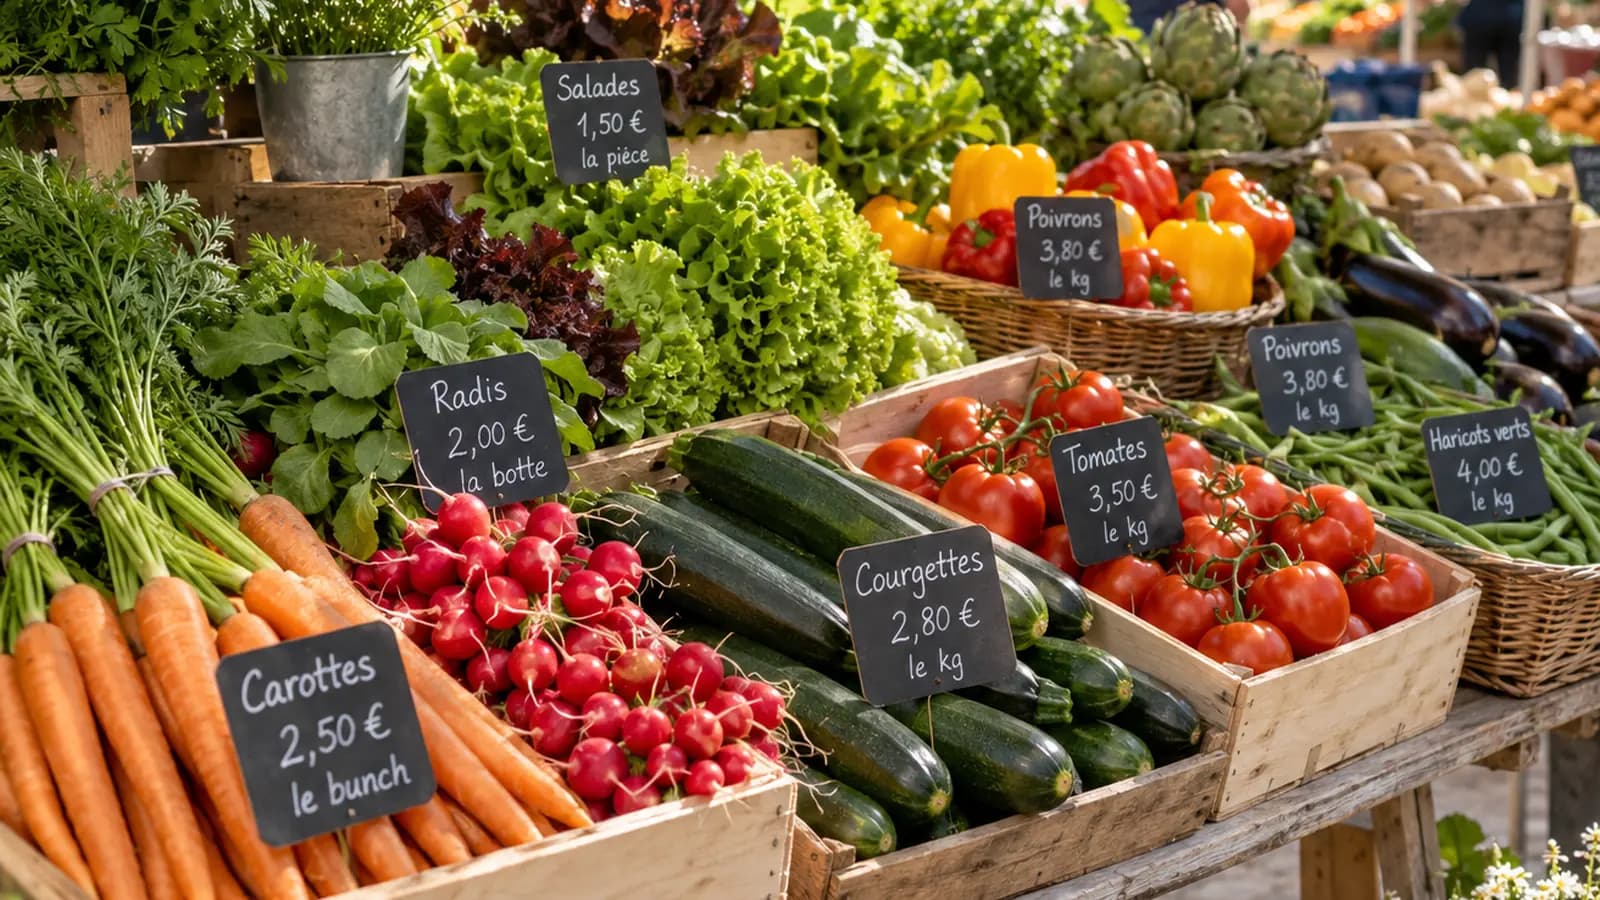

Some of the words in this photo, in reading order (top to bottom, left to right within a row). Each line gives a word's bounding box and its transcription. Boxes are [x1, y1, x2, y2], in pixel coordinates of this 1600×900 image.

[556, 71, 641, 102] Salades
[576, 111, 624, 142] 1,50
[629, 108, 647, 134] €
[581, 147, 599, 169] la
[1027, 203, 1103, 230] Poivrons
[1039, 239, 1083, 266] 3,80
[1088, 239, 1104, 262] €
[1049, 268, 1063, 289] le
[1071, 268, 1091, 296] kg
[1261, 335, 1343, 363] Poivrons
[430, 375, 508, 414] Radis
[1282, 369, 1328, 397] 3,80
[1332, 365, 1350, 389] €
[1295, 400, 1312, 422] le
[1318, 397, 1341, 425] kg
[448, 421, 506, 460] 2,00
[513, 413, 536, 442] €
[1428, 423, 1492, 452] Haricots
[1493, 416, 1532, 442] verts
[1061, 436, 1148, 475] Tomates
[1456, 456, 1502, 486] 4,00
[1506, 452, 1524, 477] €
[460, 468, 484, 494] la
[491, 455, 549, 488] botte
[1088, 479, 1136, 514] 3,50
[1140, 473, 1159, 500] €
[1471, 490, 1487, 512] le
[1493, 487, 1515, 516] kg
[1103, 520, 1120, 544] le
[1126, 515, 1149, 546] kg
[855, 549, 985, 600] Courgettes
[890, 605, 951, 645] 2,80
[958, 597, 981, 628] €
[908, 653, 928, 680] le
[938, 647, 964, 682] kg
[241, 652, 377, 714] Carottes
[279, 713, 357, 769] 2,50
[363, 702, 392, 740] €
[290, 781, 319, 818] le
[326, 753, 412, 806] bunch
